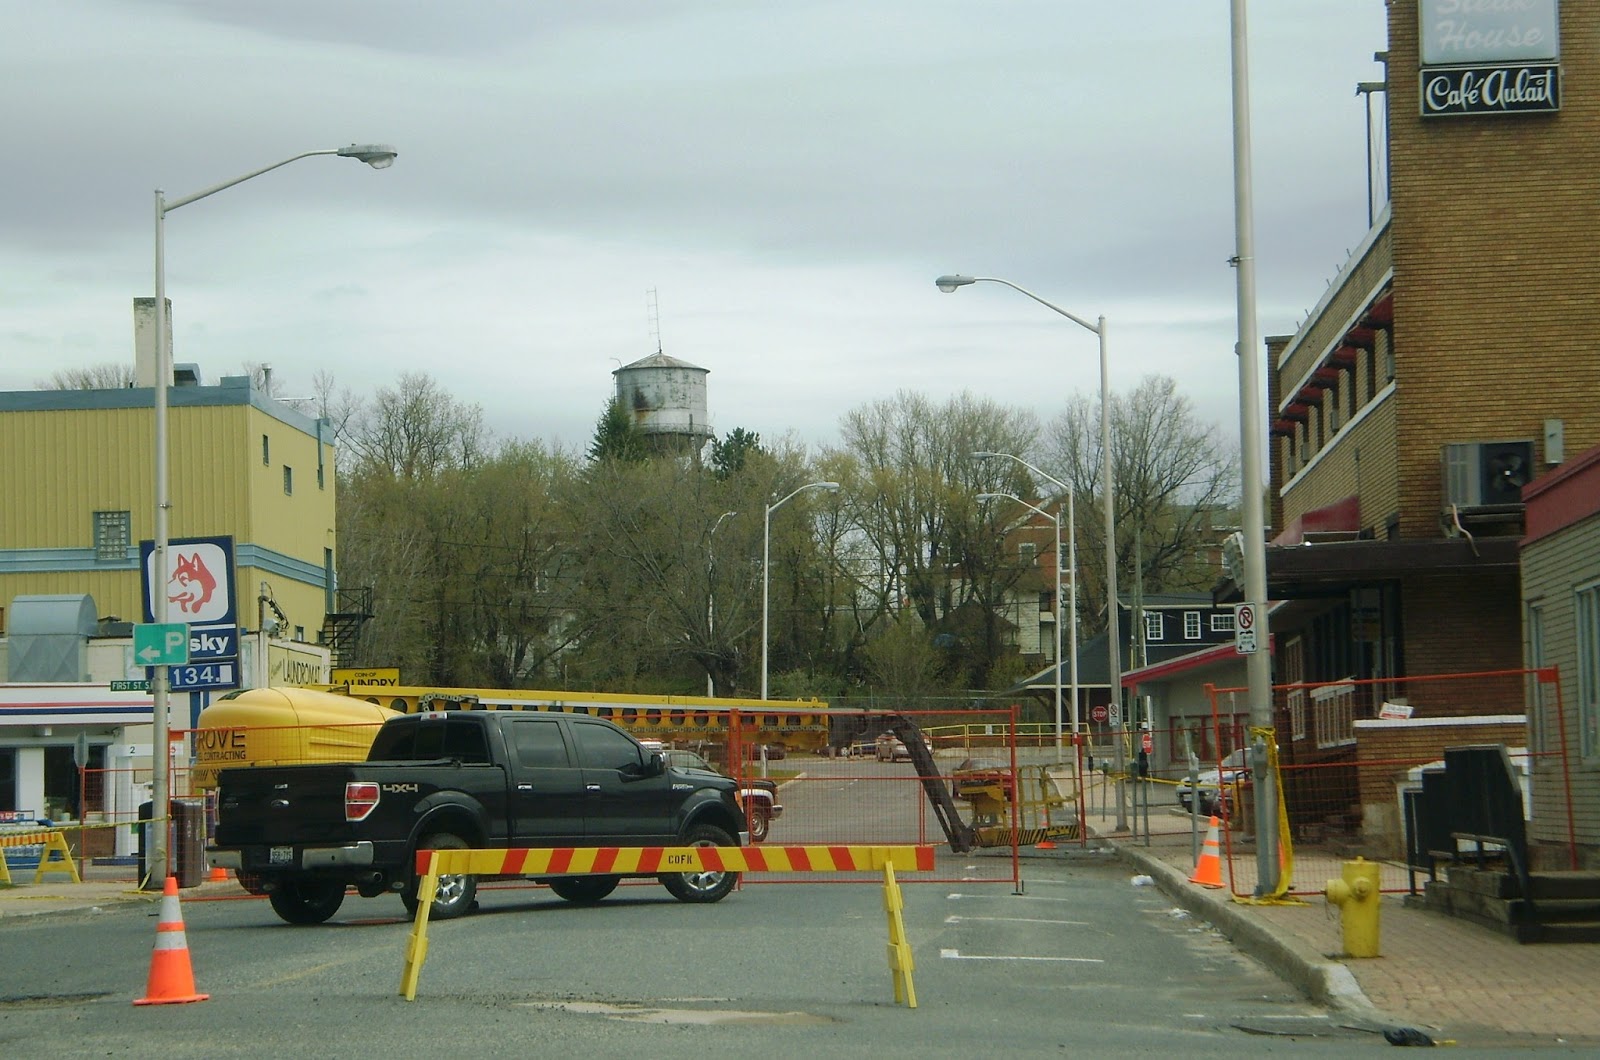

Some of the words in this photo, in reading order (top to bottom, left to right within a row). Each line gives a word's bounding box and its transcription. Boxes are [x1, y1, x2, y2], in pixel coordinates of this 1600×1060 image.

[1435, 20, 1544, 50] House
[1426, 71, 1485, 111] Café
[165, 631, 184, 654] P
[112, 681, 130, 690] FIRST
[204, 750, 246, 761] CONTRACTING
